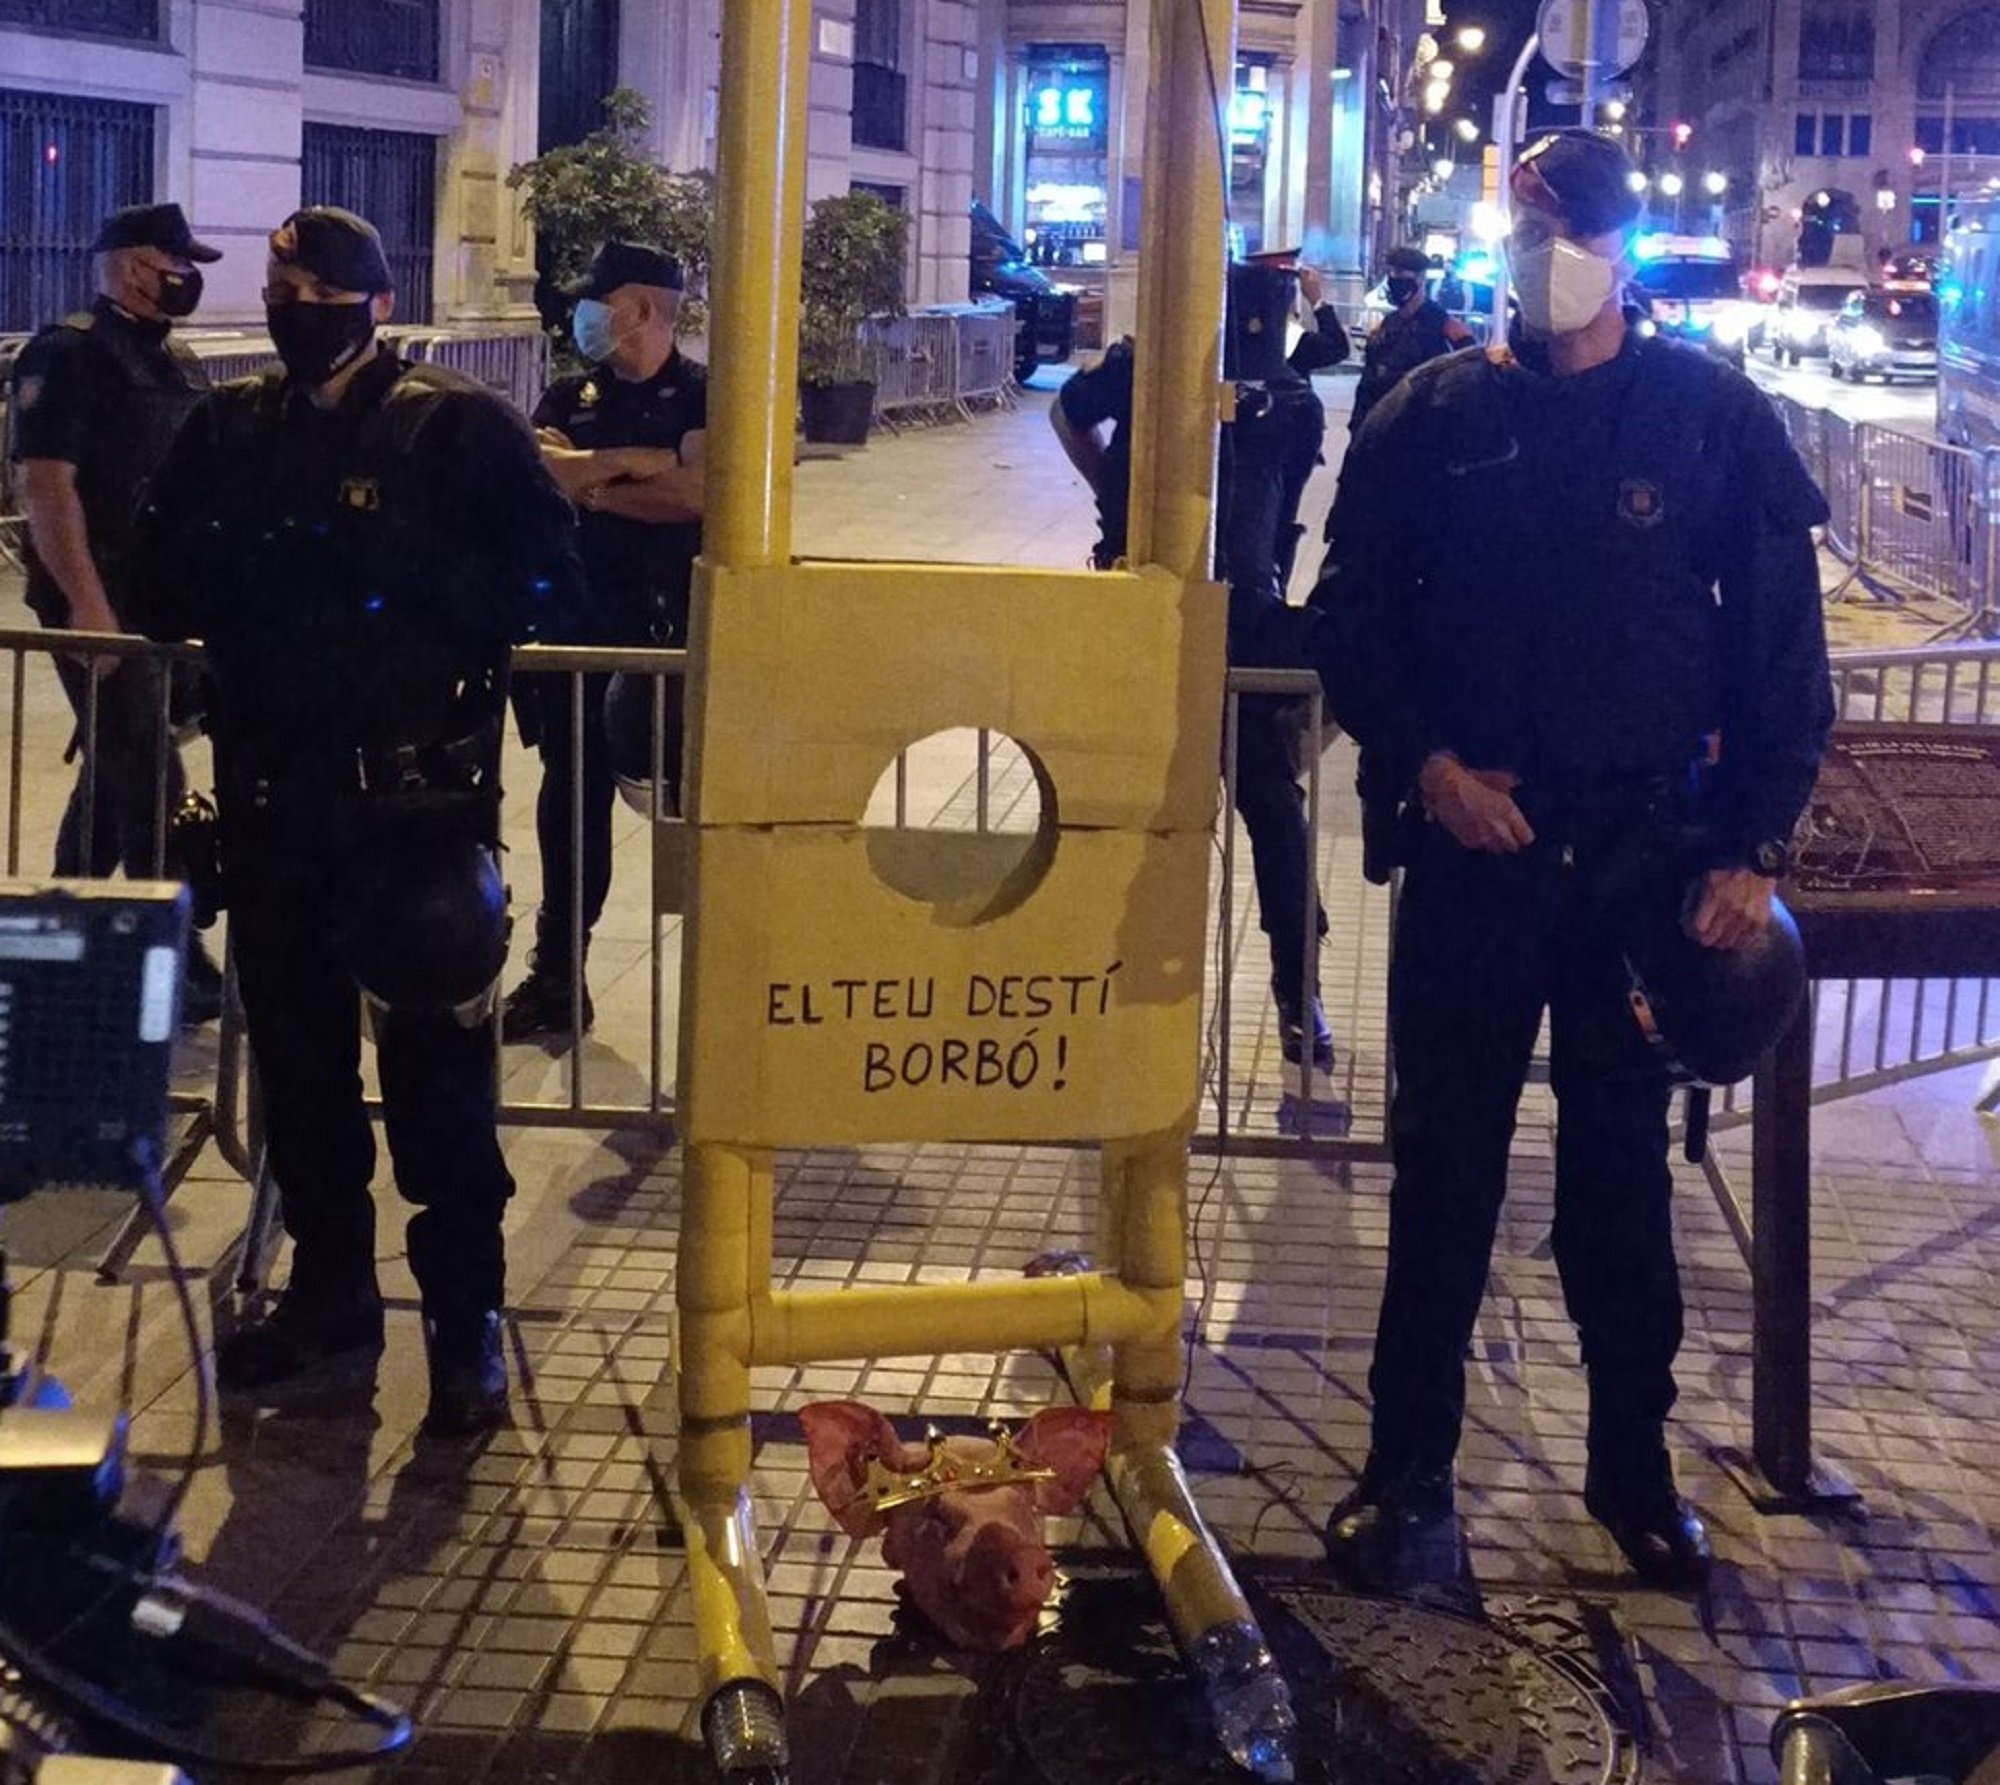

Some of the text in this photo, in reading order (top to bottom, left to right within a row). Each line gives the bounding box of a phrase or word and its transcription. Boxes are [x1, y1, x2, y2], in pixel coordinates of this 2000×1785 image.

[767, 960, 1124, 1025] EL TEU DESTÍ
[864, 1028, 1067, 1093] BORBÓ!
